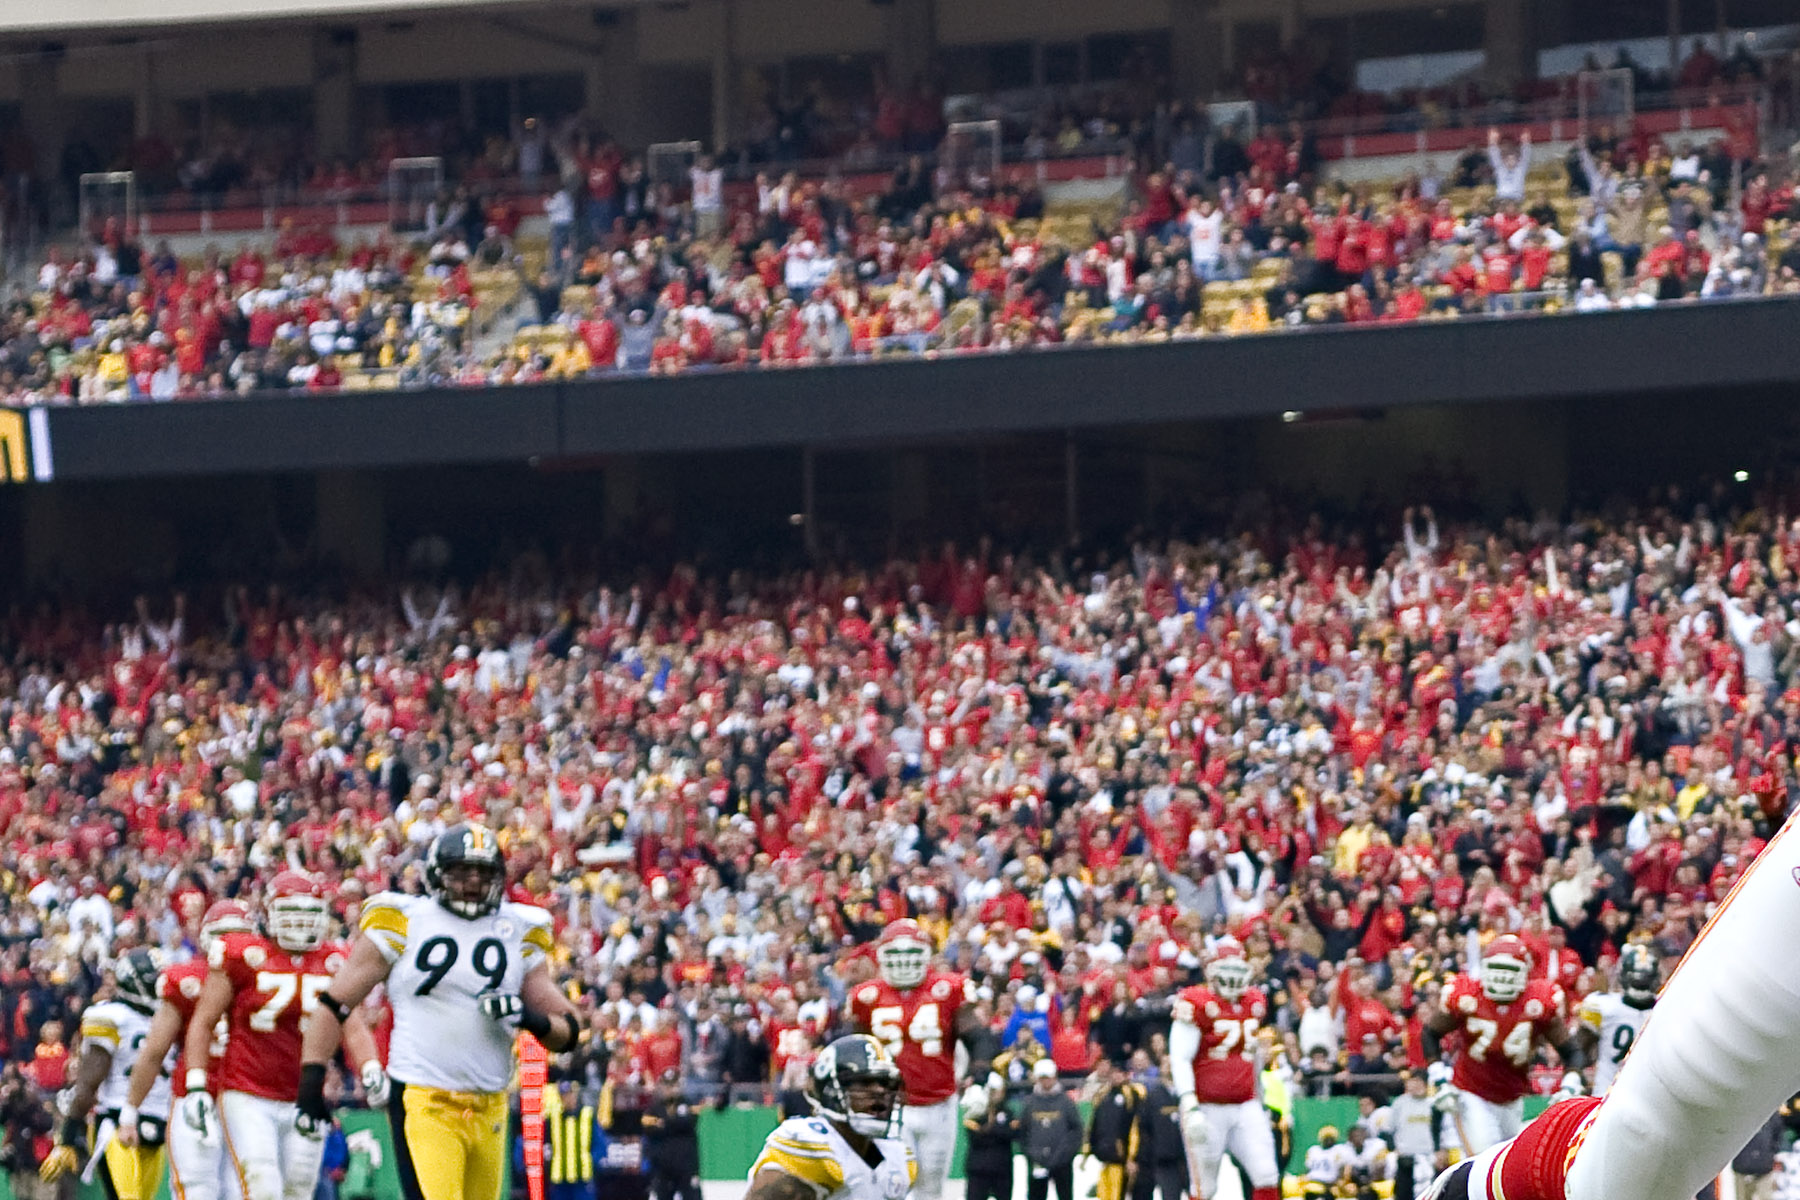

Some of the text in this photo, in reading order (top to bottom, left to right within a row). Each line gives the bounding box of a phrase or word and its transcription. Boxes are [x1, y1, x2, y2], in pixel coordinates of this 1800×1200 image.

[414, 935, 508, 998] 99
[870, 1003, 943, 1057] 54
[1466, 1017, 1533, 1068] 74
